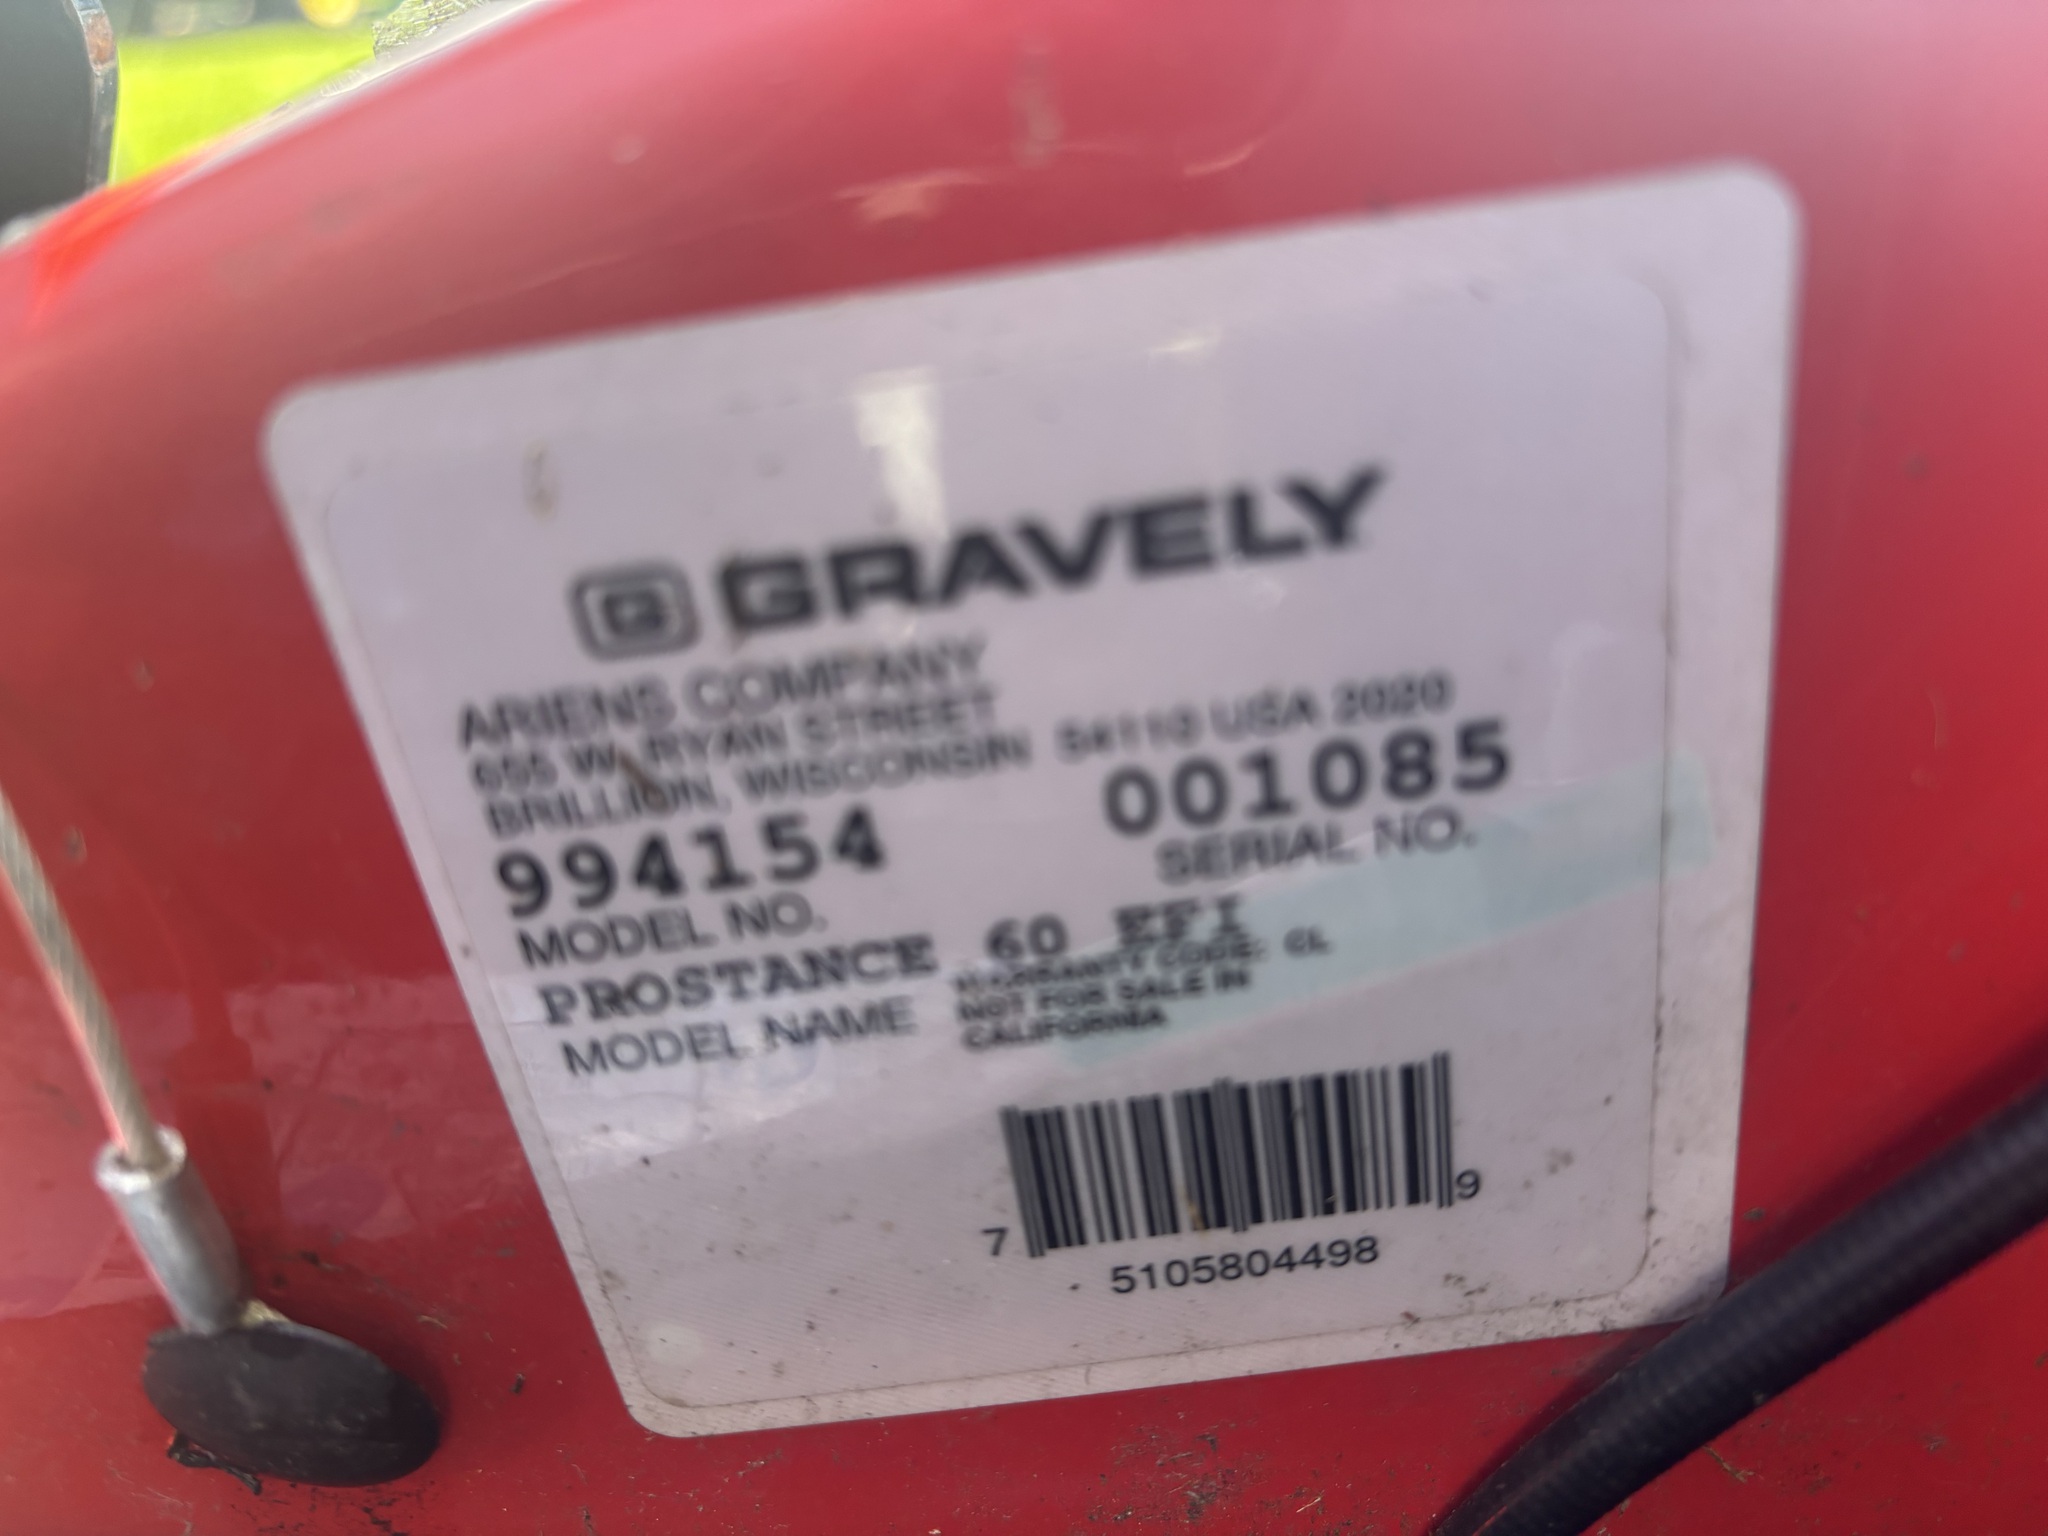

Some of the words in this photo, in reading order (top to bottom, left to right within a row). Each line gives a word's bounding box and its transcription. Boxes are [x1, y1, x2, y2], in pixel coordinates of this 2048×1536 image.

[720, 466, 1384, 630] GRAVELY
[460, 678, 672, 750] ARIENS
[686, 636, 984, 724] COMPANY
[641, 722, 790, 764] RYAN
[800, 688, 998, 746] STREET
[738, 732, 1032, 804] WISCONSIN
[1056, 708, 1202, 762] 54110
[1210, 688, 1320, 740] USA
[1334, 670, 1454, 726] 2020
[1104, 718, 1512, 838] 001085
[498, 806, 888, 918] 994154
[1156, 822, 1360, 886] SERIAL
[1374, 804, 1478, 858] NO.
[518, 906, 716, 968] MODEL
[726, 890, 828, 938] NO.
[540, 934, 936, 1026] PROSTANCE
[986, 914, 1068, 962] 60
[1114, 894, 1246, 946] EFI
[957, 990, 1026, 1022] NOT
[1036, 980, 1108, 1012] FOR
[1116, 968, 1206, 1002] SALE
[1214, 966, 1252, 992] IN
[962, 1004, 1168, 1050] CALIFORNIA
[562, 1022, 752, 1076] MODEL
[762, 996, 920, 1046] NAME
[1456, 1170, 1482, 1199] 9
[983, 1228, 1009, 1256] 7
[1110, 1236, 1380, 1294] 5105804498
